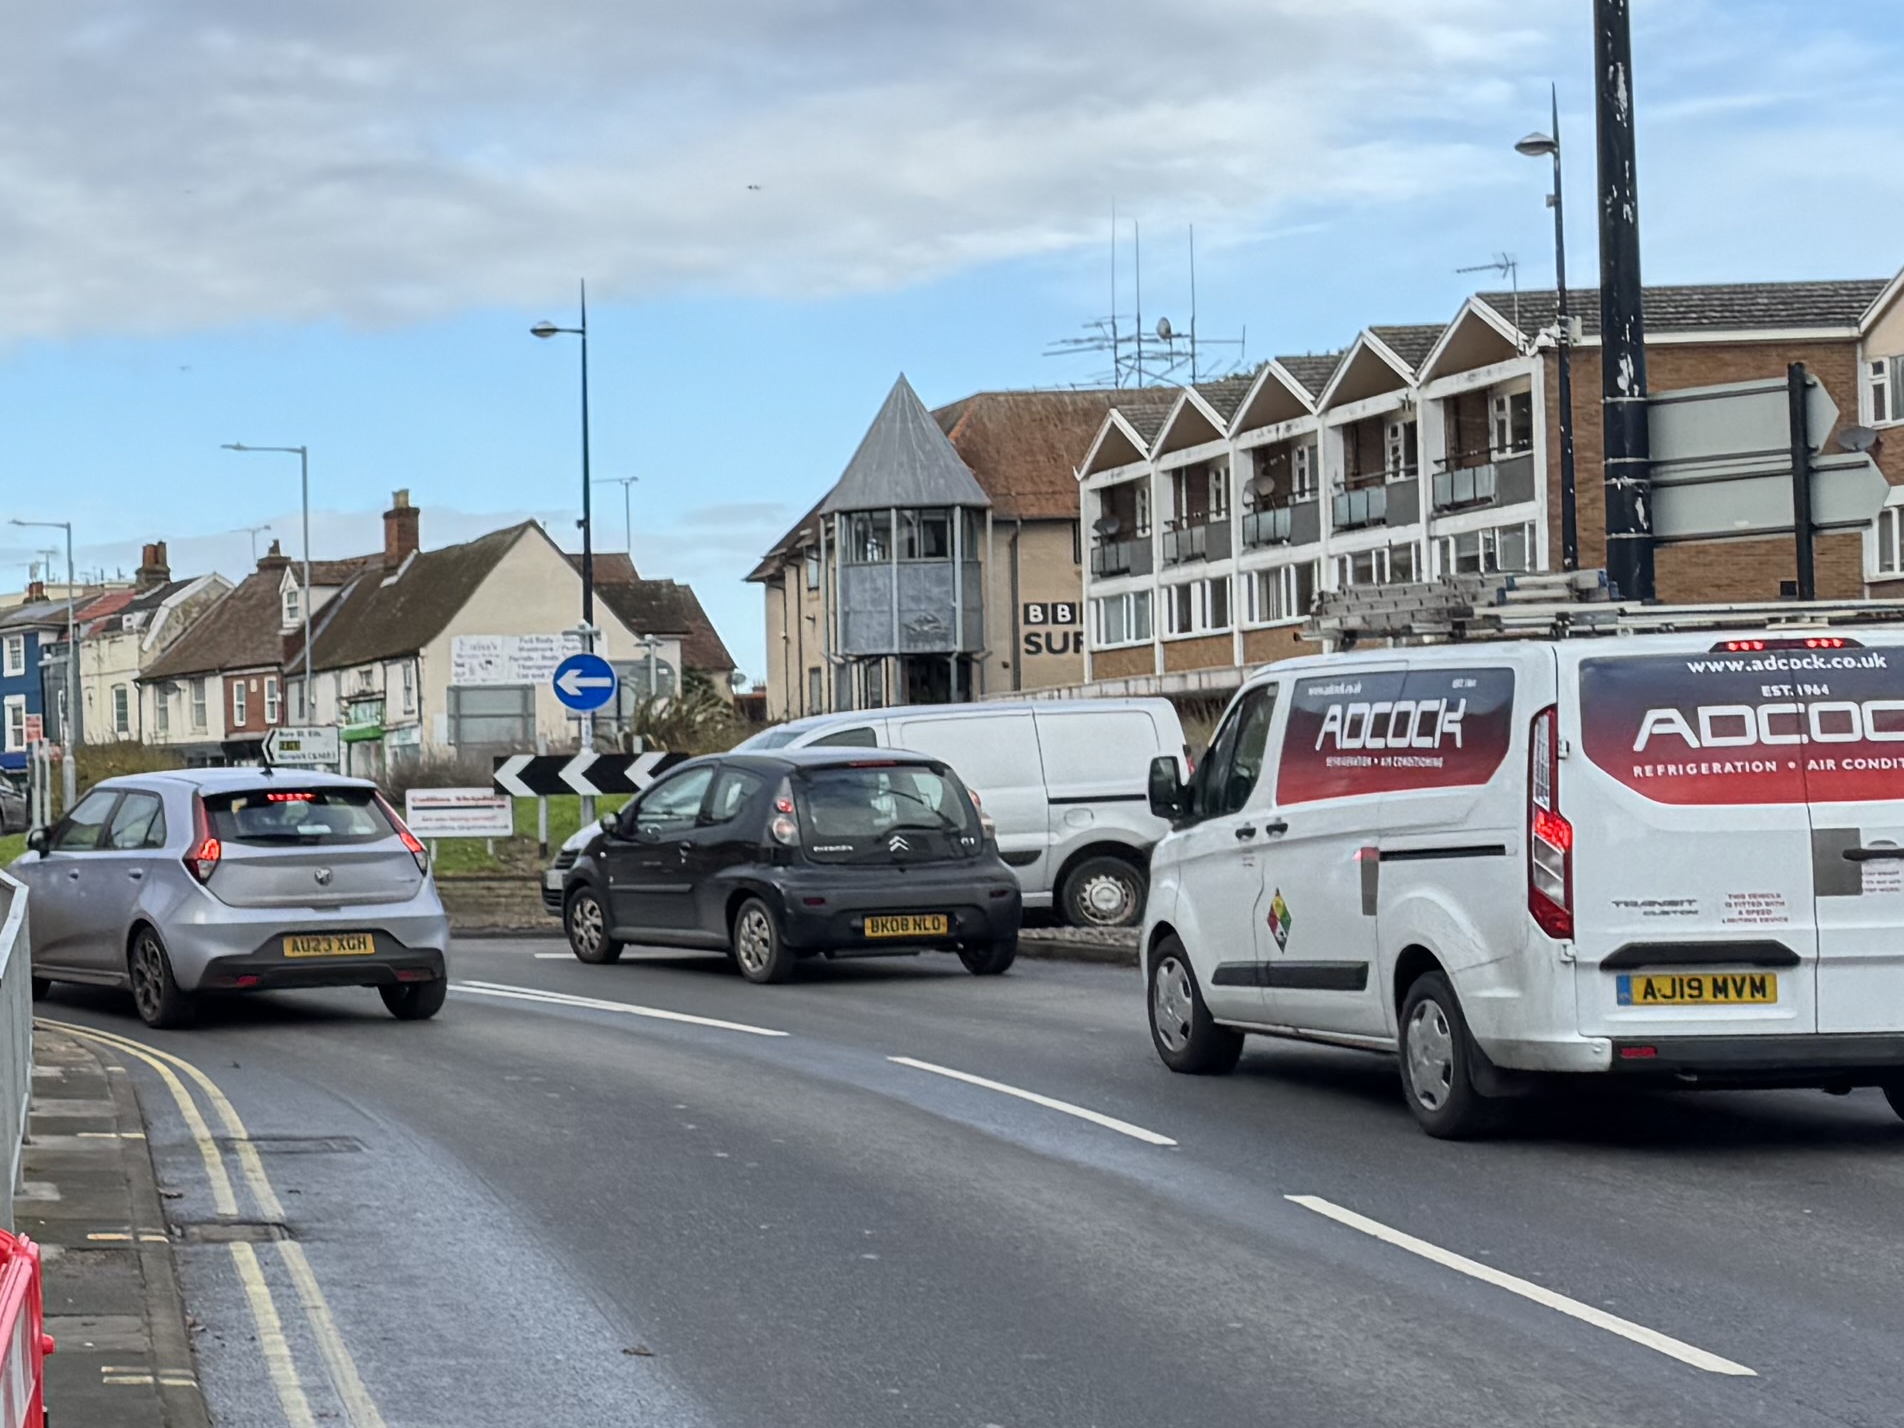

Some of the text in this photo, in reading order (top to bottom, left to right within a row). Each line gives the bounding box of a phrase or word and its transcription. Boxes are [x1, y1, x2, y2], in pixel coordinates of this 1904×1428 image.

[1686, 651, 1888, 674] www.adcock.co.uk
[1761, 683, 1830, 698] EST. 1964
[1315, 697, 1467, 751] ADCOCK
[1632, 699, 1904, 752] ADCOC
[1632, 759, 1778, 778] REFRIGERATION
[1807, 759, 1837, 771] AIR
[1611, 898, 1698, 909] TRANSIT
[292, 936, 332, 953] AU23
[1642, 977, 1768, 1001] AJ19 MVM
